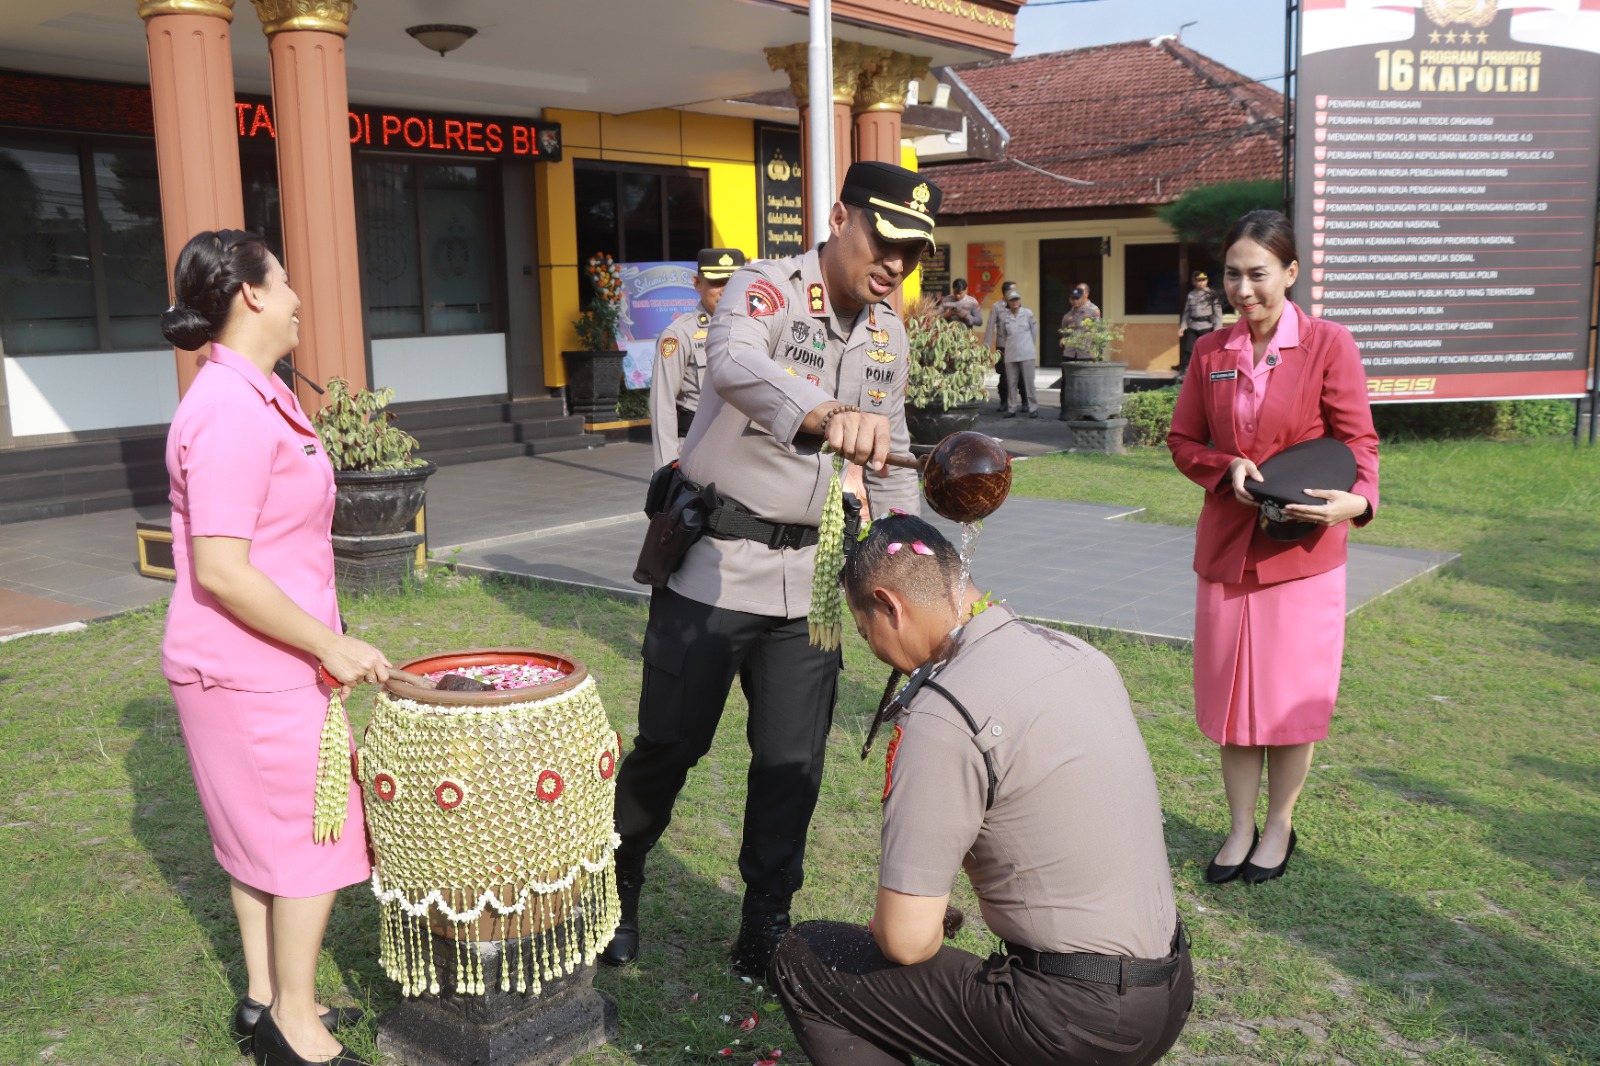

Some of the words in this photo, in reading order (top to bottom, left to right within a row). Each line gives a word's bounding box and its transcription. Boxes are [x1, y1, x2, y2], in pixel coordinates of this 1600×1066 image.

[1374, 49, 1415, 91] 16
[1420, 50, 1478, 65] PROGRAM
[1481, 50, 1542, 65] PRIORITAS
[1419, 66, 1540, 92] KAPOLRI
[382, 113, 504, 153] POLRES
[1395, 133, 1416, 142] POLRI
[784, 343, 825, 369] YUDHO
[866, 367, 895, 383] POLRI
